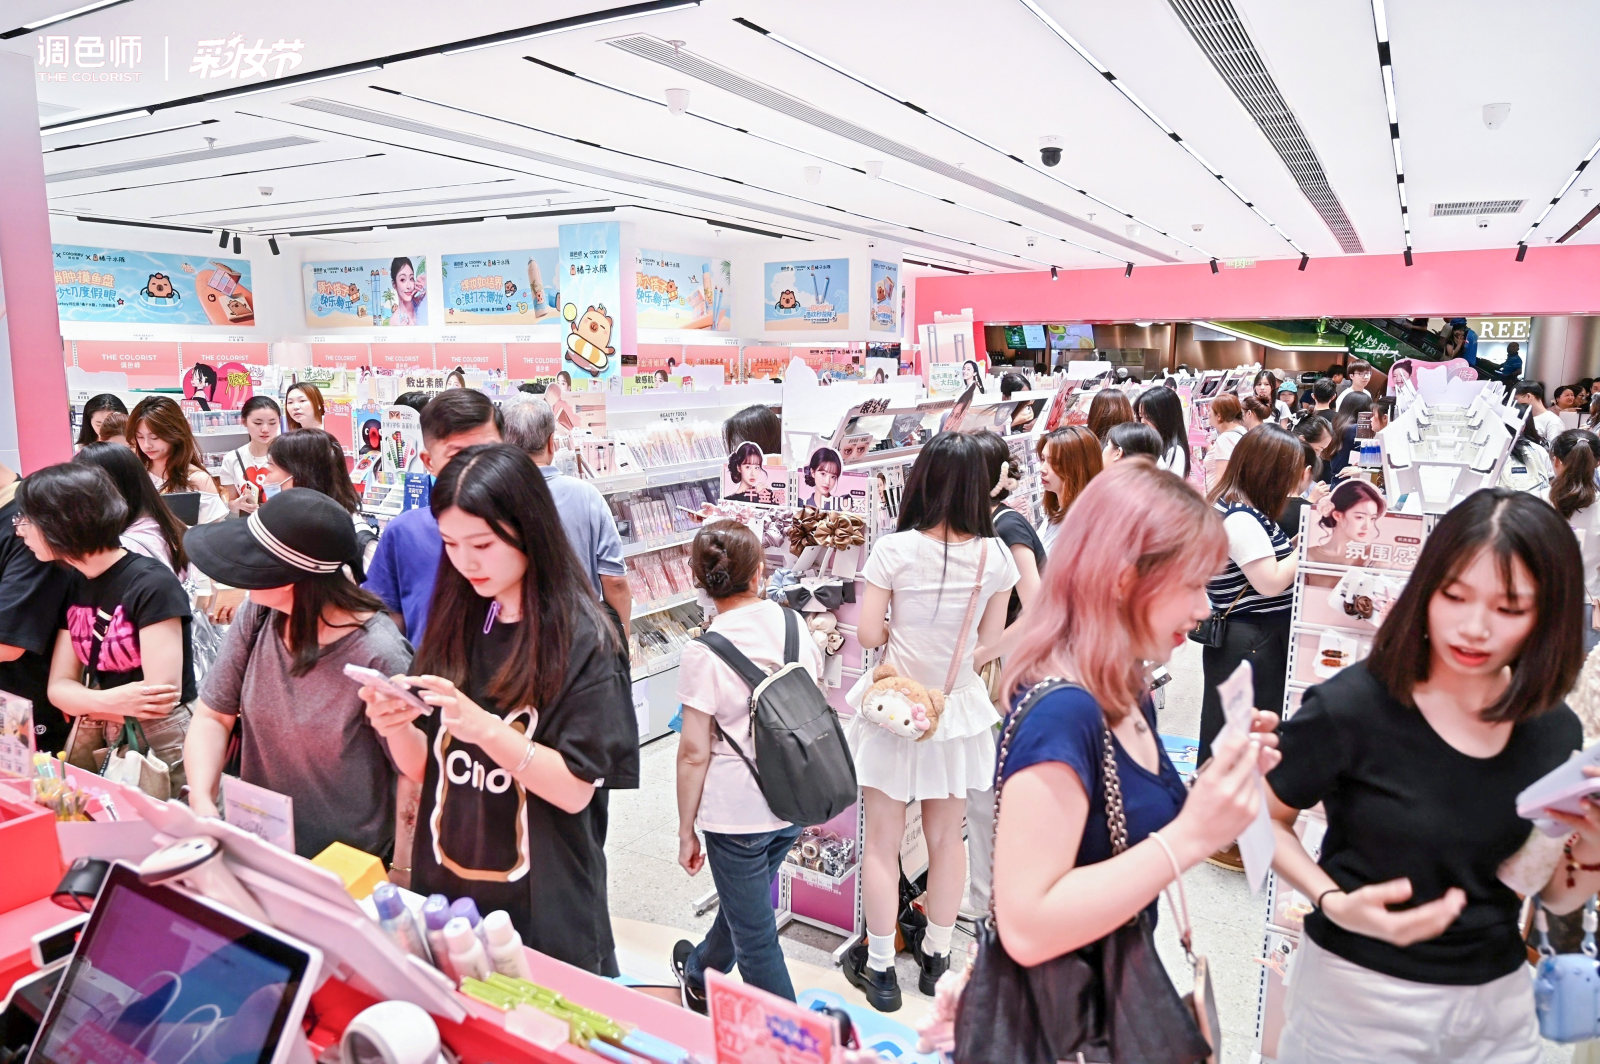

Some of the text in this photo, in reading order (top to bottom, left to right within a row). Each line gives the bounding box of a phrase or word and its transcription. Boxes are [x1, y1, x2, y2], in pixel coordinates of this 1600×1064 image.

[1479, 320, 1531, 339] REE
[1344, 540, 1419, 566] 氛围感
